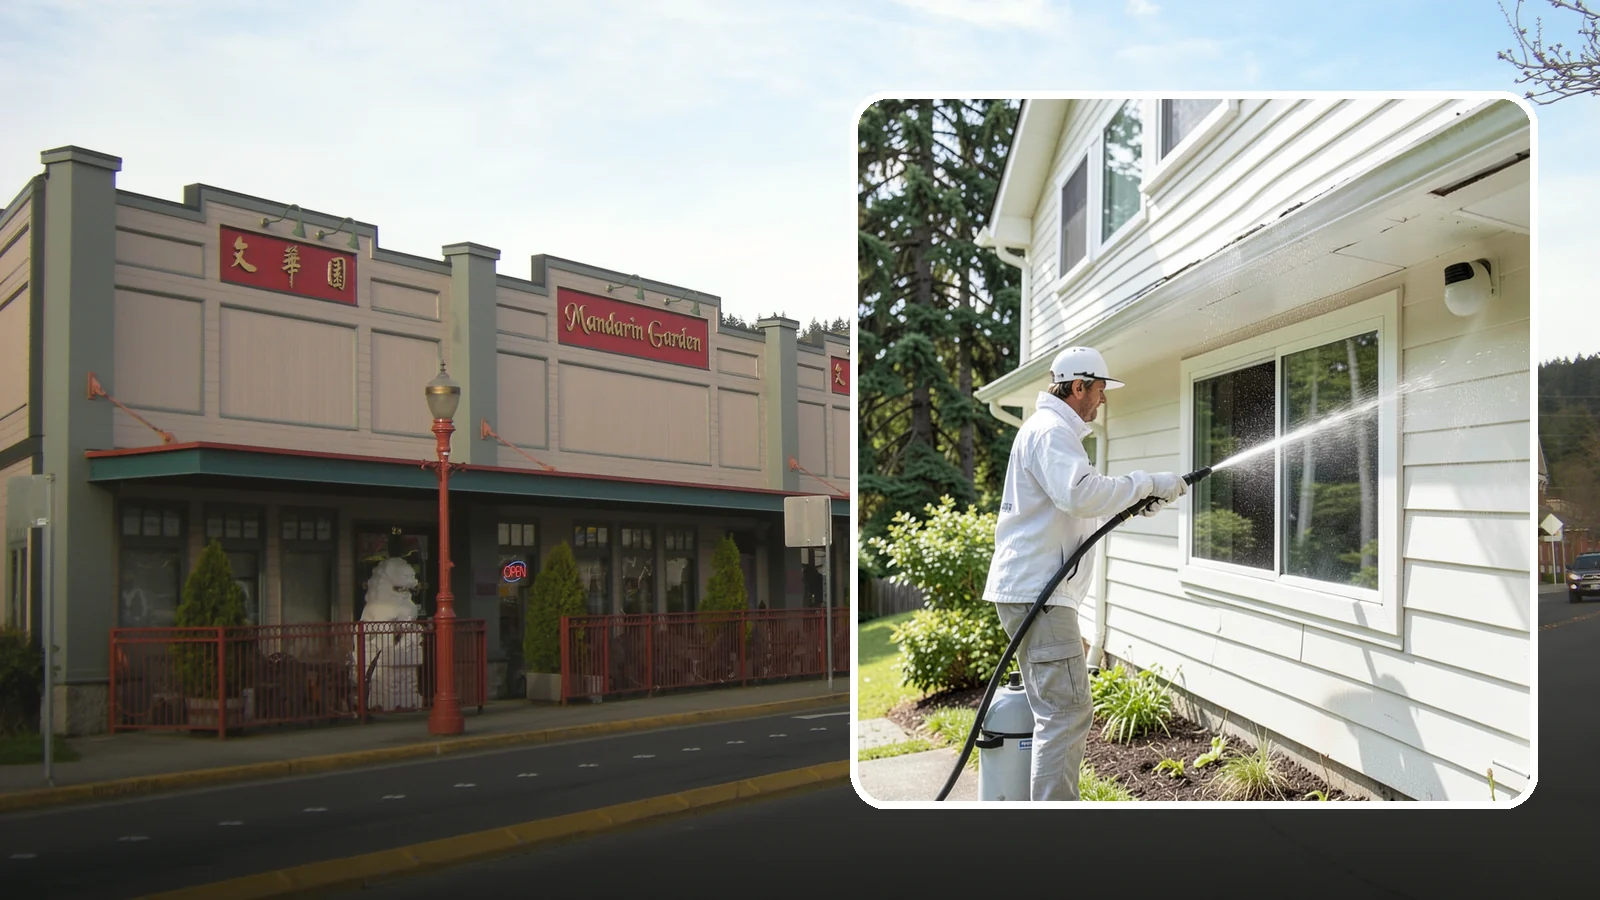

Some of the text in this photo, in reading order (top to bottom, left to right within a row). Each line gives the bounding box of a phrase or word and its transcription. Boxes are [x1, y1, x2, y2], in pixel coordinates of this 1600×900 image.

[564, 302, 702, 352] Mandarin Garden
[503, 565, 527, 578] OPEN
